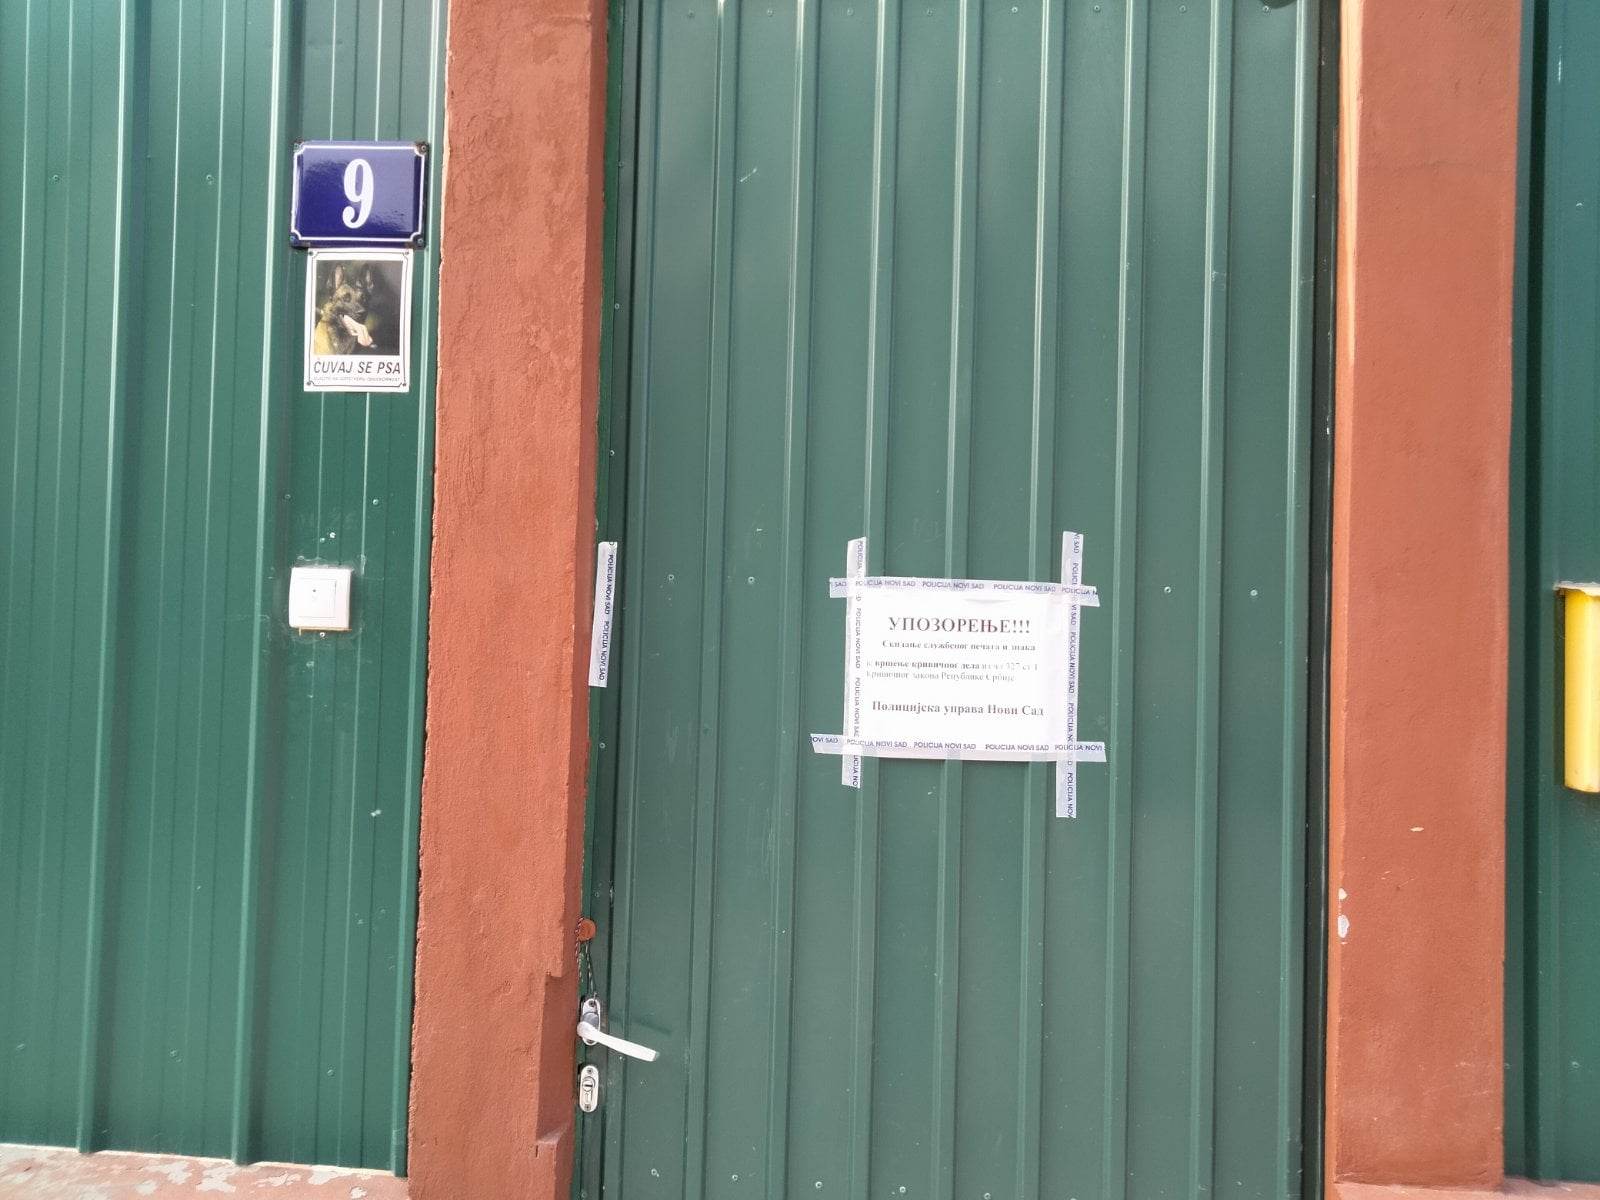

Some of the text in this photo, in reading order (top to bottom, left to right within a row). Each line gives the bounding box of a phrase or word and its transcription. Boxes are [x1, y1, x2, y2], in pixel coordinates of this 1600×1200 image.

[343, 158, 374, 229] 9
[357, 361, 373, 374] SE
[377, 361, 401, 375] PSA
[993, 583, 1023, 591] POLICIJA
[888, 616, 1030, 634] УПОЗОРЕЊЕ!!!
[602, 620, 610, 649] POLICIJA
[1069, 631, 1077, 661] POLICIJA
[872, 700, 1044, 716] Полицијска управа Нови Сад
[875, 740, 893, 748] NOVI
[913, 741, 943, 749] POLICIJA
[985, 743, 1015, 751] POLICIJA
